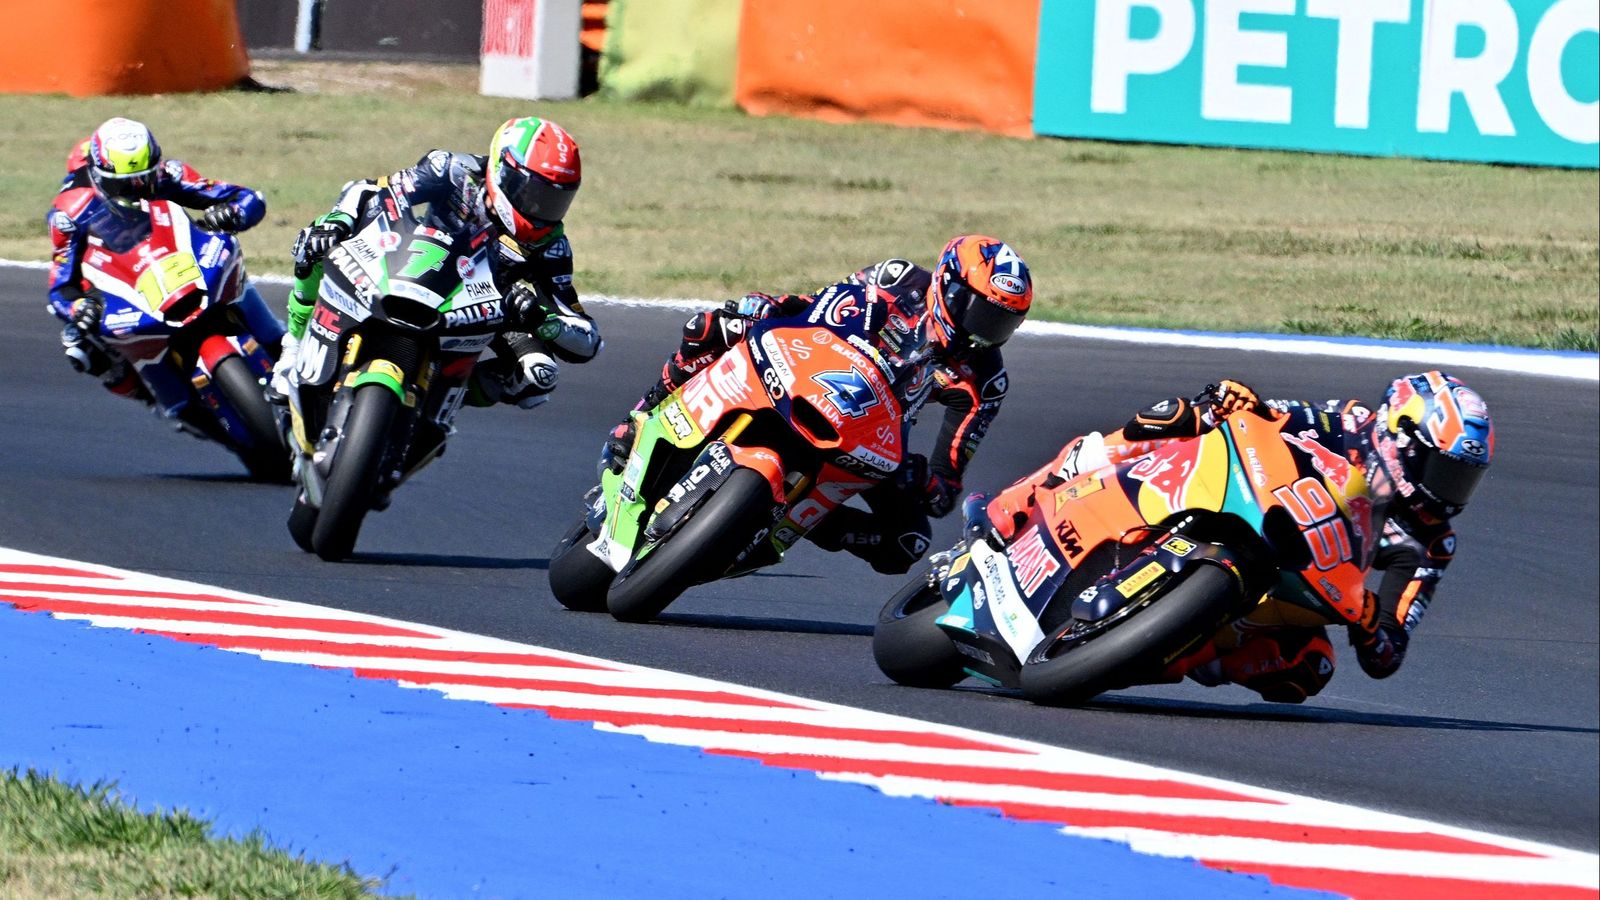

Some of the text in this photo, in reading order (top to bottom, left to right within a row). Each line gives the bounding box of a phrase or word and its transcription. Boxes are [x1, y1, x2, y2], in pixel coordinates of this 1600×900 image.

[350, 238, 379, 263] FIAMM
[397, 239, 451, 279] 7
[328, 247, 380, 304] PALLEX
[465, 281, 495, 299] FIAMM
[444, 300, 504, 329] PALLEX
[810, 366, 881, 420] 4
[830, 343, 897, 421] audio-technica
[805, 394, 845, 429] ALIUM
[1055, 519, 1086, 560] KTM
[1272, 477, 1353, 571] 95
